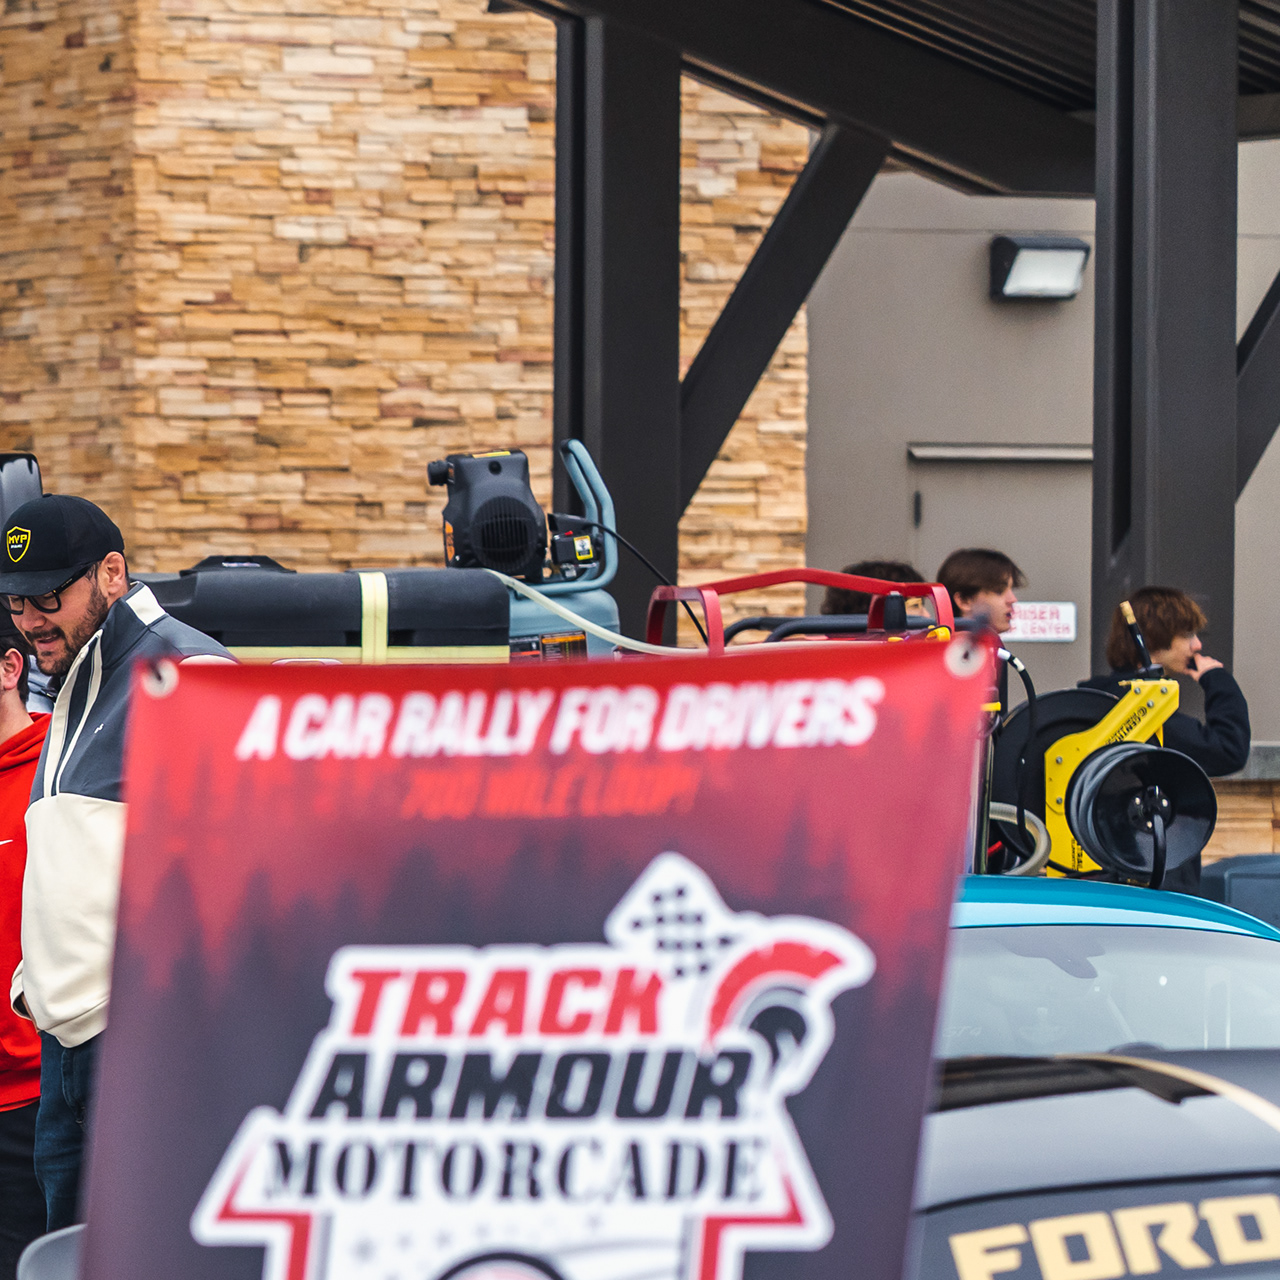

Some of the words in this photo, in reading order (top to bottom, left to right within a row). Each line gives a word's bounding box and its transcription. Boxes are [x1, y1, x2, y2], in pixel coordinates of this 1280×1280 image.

[235, 693, 282, 761] A
[284, 691, 395, 761] CAR
[391, 687, 555, 759] RALLY
[548, 684, 660, 756] FOR
[657, 676, 886, 751] DRIVERS
[346, 967, 666, 1039] TRACK
[304, 1048, 754, 1121] ARMOUR
[264, 1136, 767, 1204] MOTORCADE
